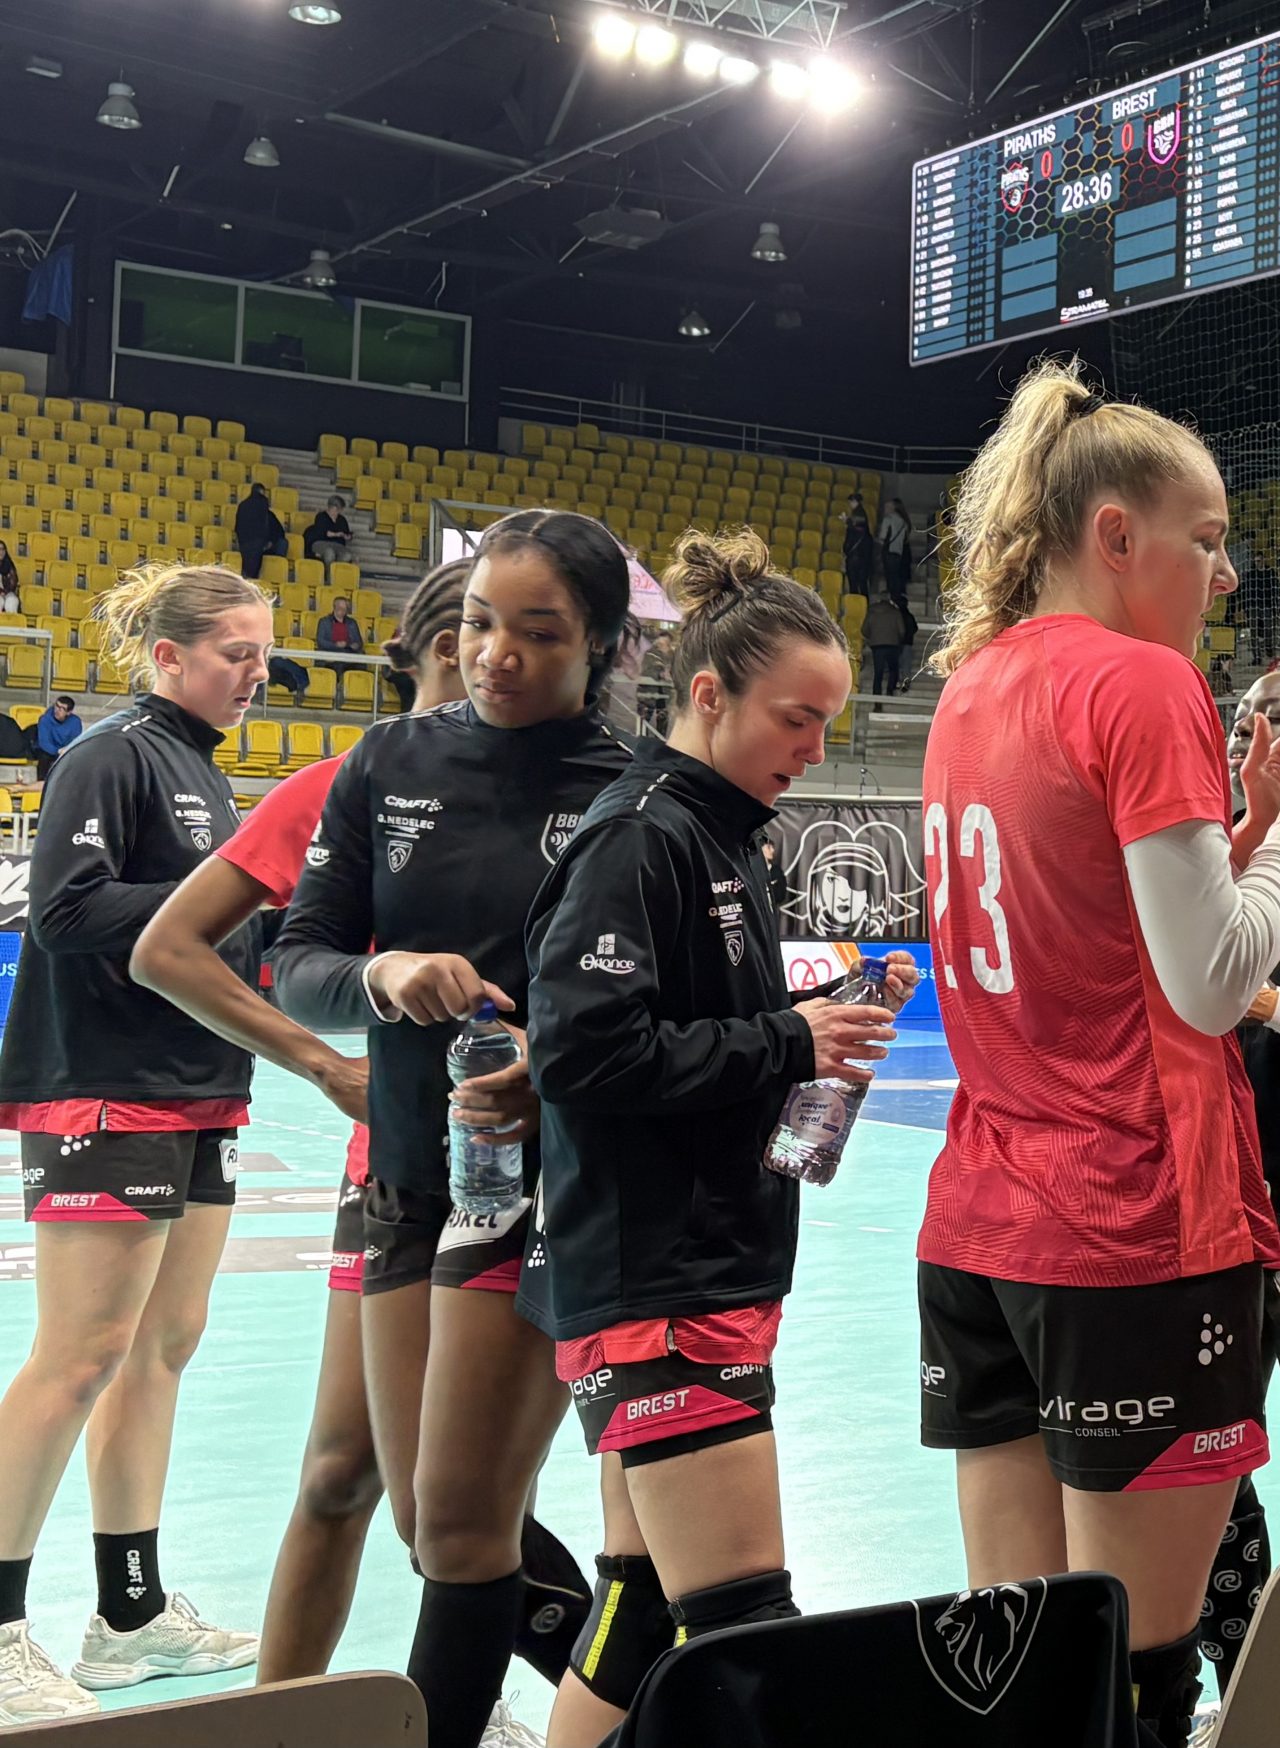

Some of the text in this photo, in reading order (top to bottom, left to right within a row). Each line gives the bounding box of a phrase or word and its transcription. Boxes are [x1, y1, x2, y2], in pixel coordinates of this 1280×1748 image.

[1112, 88, 1157, 120] BREST
[1004, 124, 1056, 158] PIRATHS
[1121, 123, 1133, 152] 0
[1041, 151, 1053, 178] 0
[1061, 172, 1112, 213] 28:36
[384, 795, 431, 810] CRAFT
[925, 802, 1014, 994] 23
[51, 1194, 100, 1207] BREST
[125, 1186, 166, 1196] CRAFT
[627, 1390, 690, 1421] BREST
[1039, 1394, 1175, 1426] virage
[1075, 1427, 1121, 1438] CONSEIL
[1193, 1423, 1247, 1455] BREST
[126, 1549, 143, 1584] CRAFT
